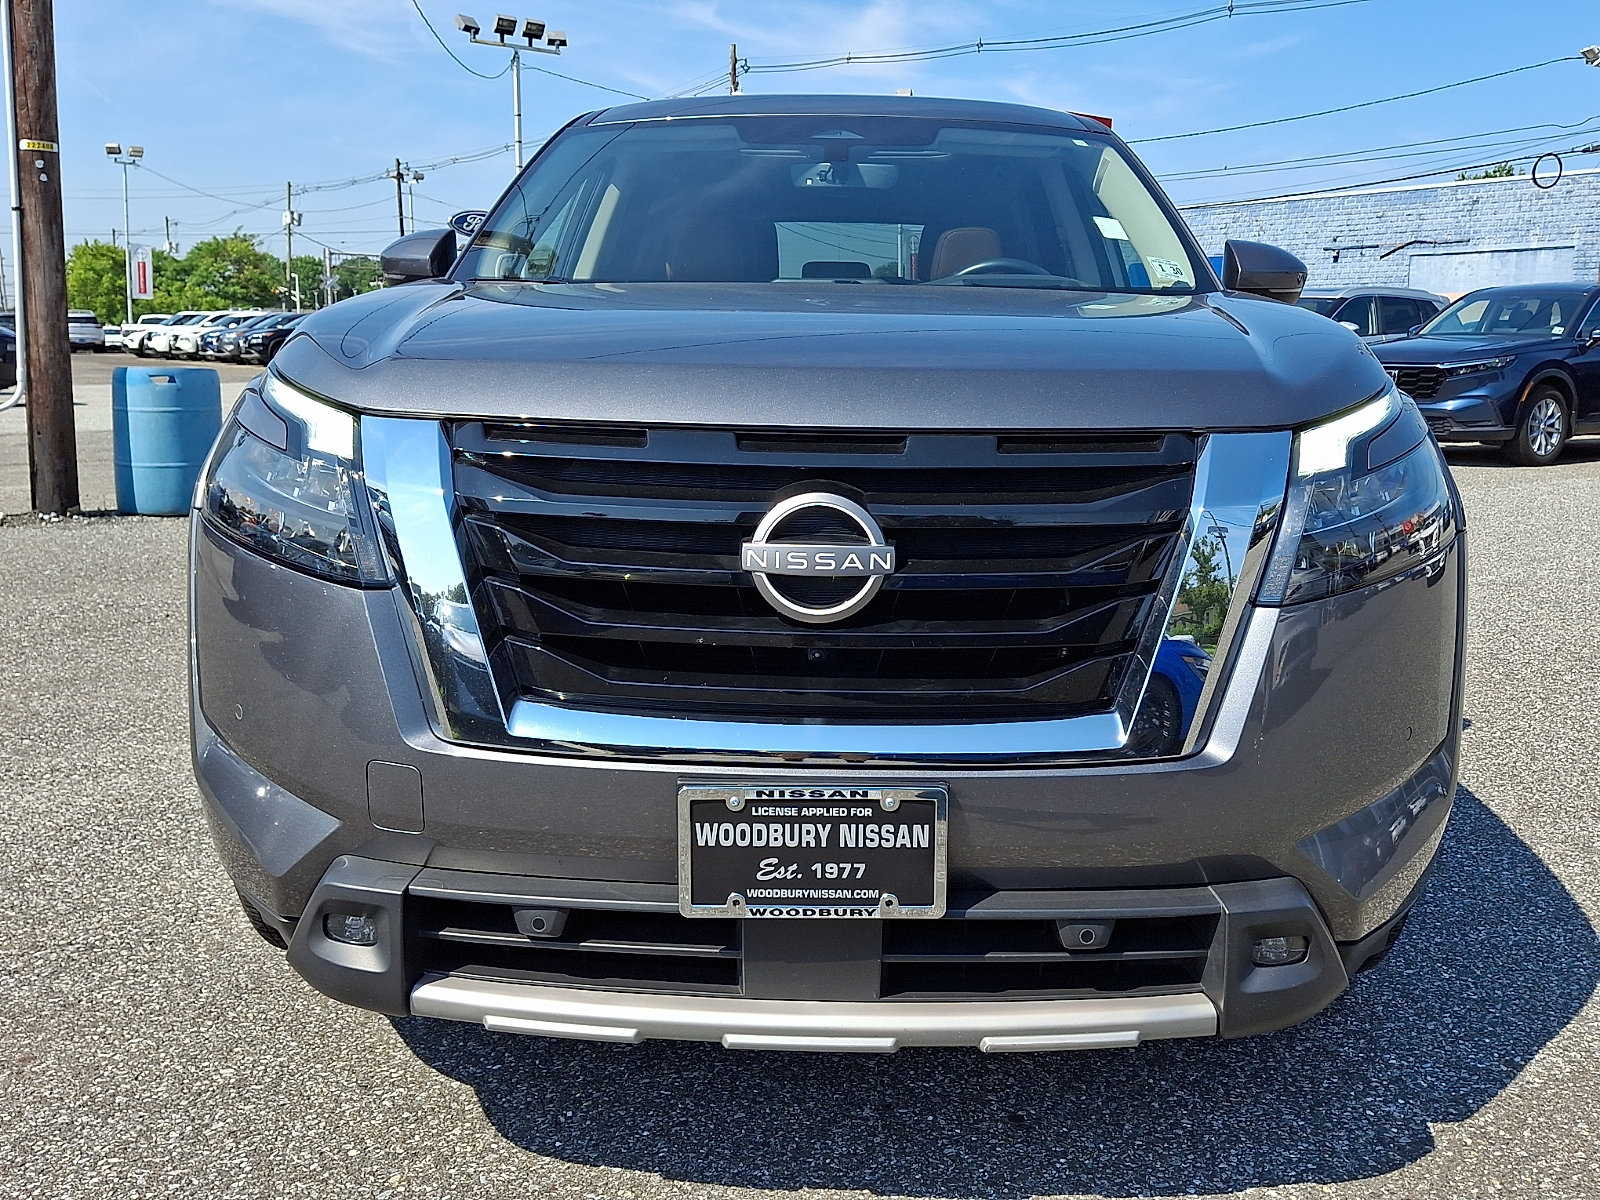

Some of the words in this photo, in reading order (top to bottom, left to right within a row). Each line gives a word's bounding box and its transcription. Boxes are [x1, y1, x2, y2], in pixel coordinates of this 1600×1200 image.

[746, 549, 891, 570] NISSAN
[755, 789, 869, 798] NISSAN
[751, 806, 799, 817] LICENSE
[800, 807, 847, 817] APPLIED
[850, 807, 873, 817] FOR
[695, 822, 832, 848] WOODBURY
[839, 823, 930, 848] NISSAN
[756, 857, 803, 881] Est.
[811, 863, 867, 879] 1977
[746, 888, 880, 899] WOODBURYNISSAN.COM
[749, 907, 878, 917] WOODBURY
